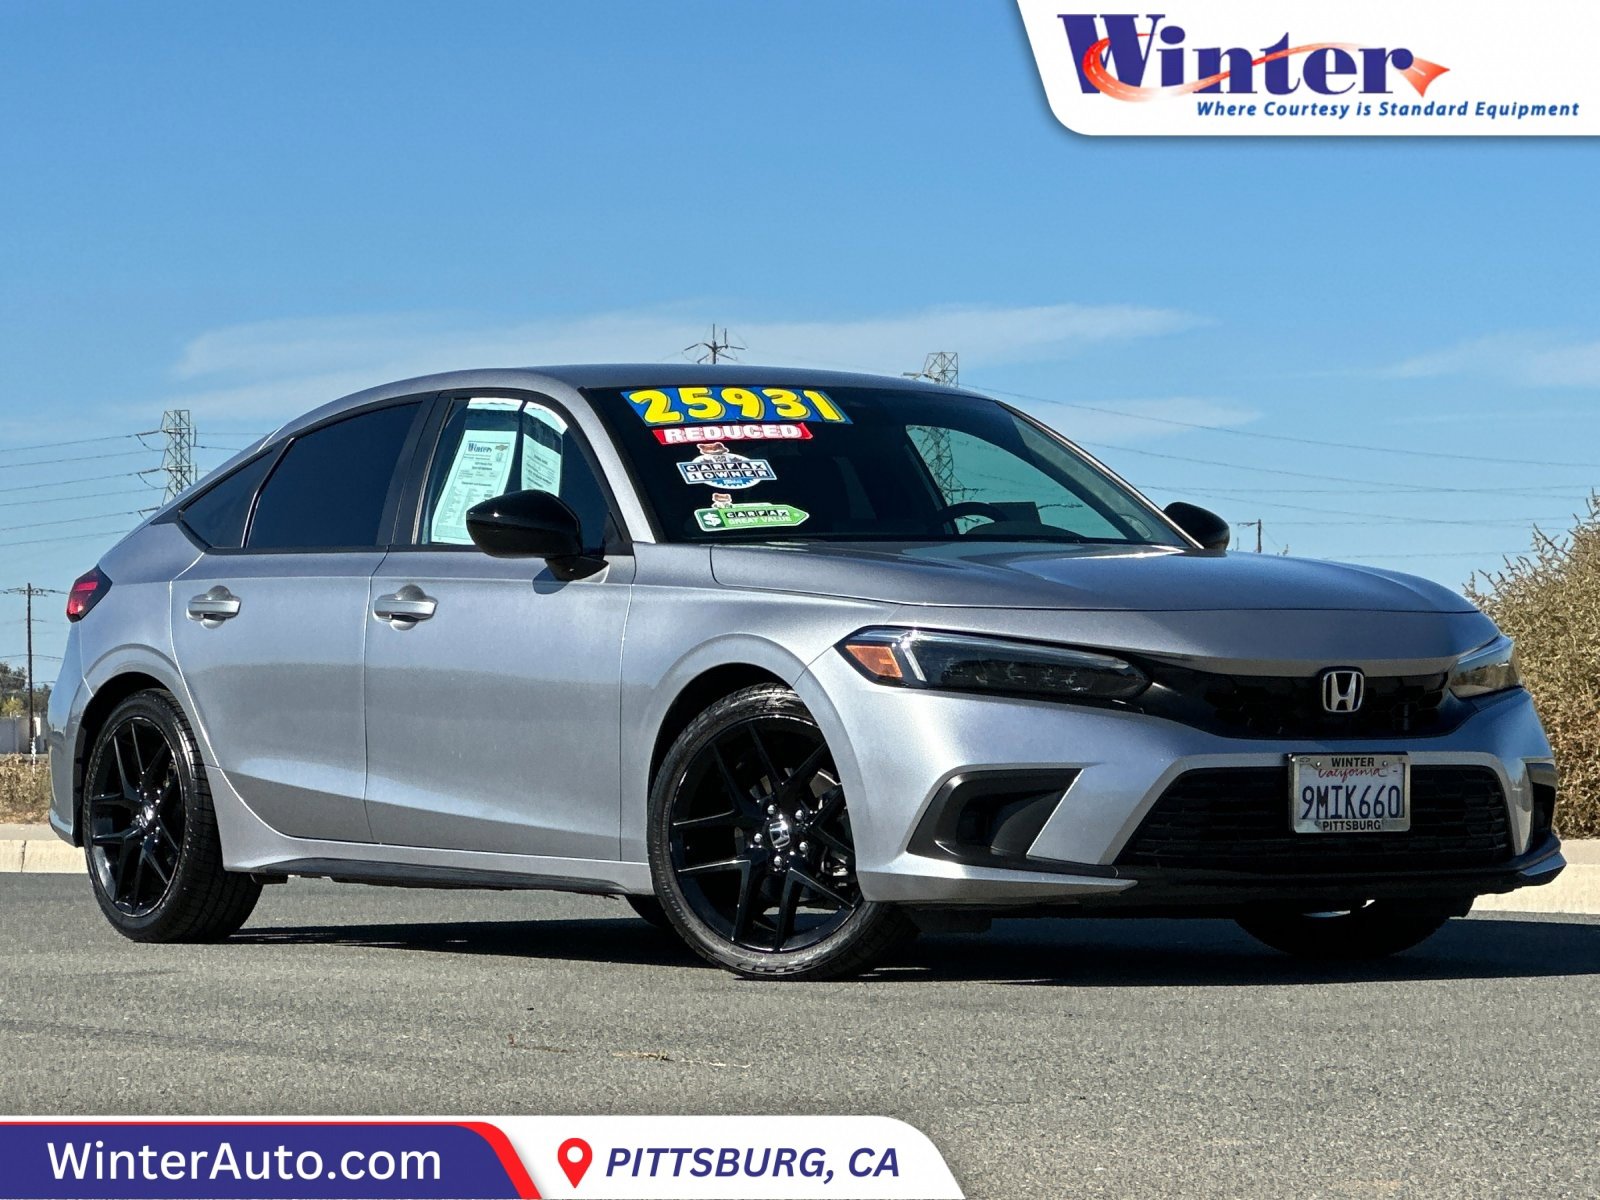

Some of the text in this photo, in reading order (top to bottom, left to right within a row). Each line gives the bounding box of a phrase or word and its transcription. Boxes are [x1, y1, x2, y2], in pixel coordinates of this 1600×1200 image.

[628, 386, 843, 425] 25931
[663, 423, 802, 444] REDUCED
[684, 462, 765, 473] CARFAX
[702, 470, 769, 480] OWNER
[725, 509, 790, 518] CARFAX
[729, 515, 792, 525] GREAT VALUE
[1331, 757, 1375, 768] WINTER
[1301, 785, 1401, 820] 9MIK660
[1322, 820, 1382, 831] PITTSBURG
